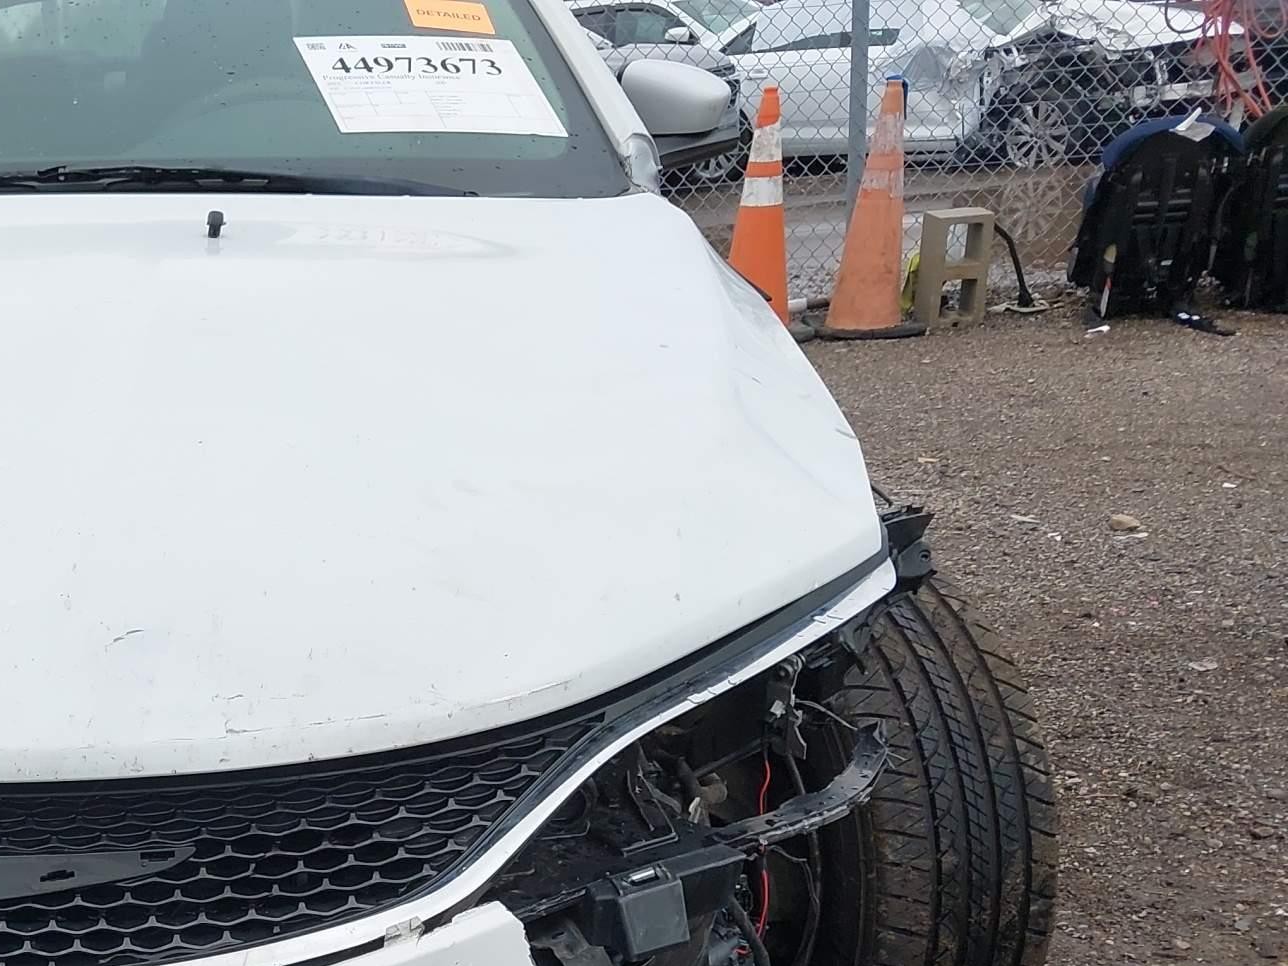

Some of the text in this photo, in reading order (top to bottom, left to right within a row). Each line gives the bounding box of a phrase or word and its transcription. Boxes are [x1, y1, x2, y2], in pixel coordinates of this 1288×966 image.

[416, 9, 481, 21] DETAILED
[332, 56, 502, 76] 44973673
[377, 73, 416, 81] Casualty
